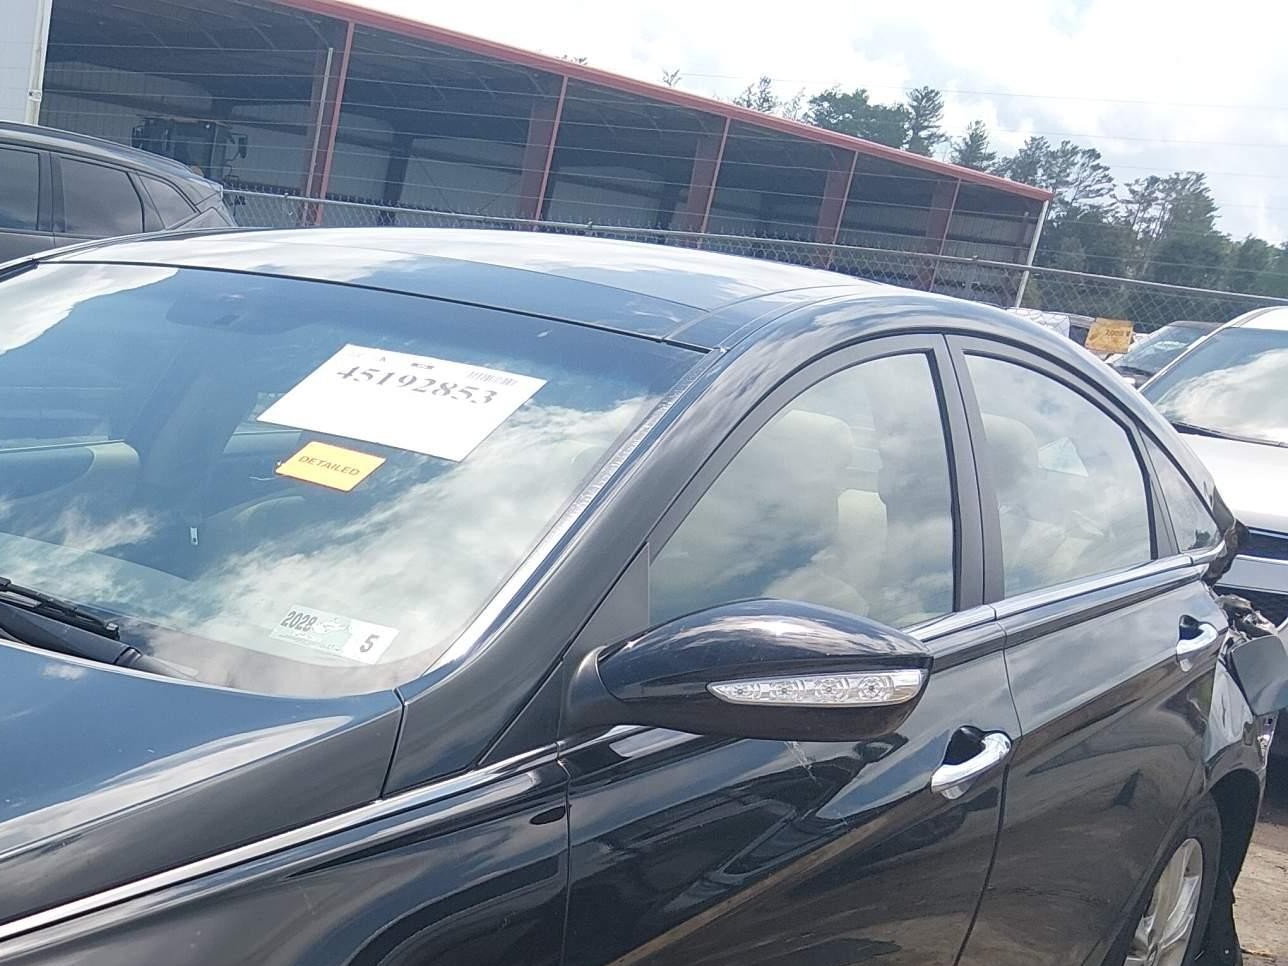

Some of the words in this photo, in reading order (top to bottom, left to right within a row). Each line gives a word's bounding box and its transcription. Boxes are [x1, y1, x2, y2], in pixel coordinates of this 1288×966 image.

[336, 365, 499, 404] 45192853
[298, 455, 361, 476] DETAILED
[280, 610, 318, 632] 2028
[359, 634, 380, 653] 5
